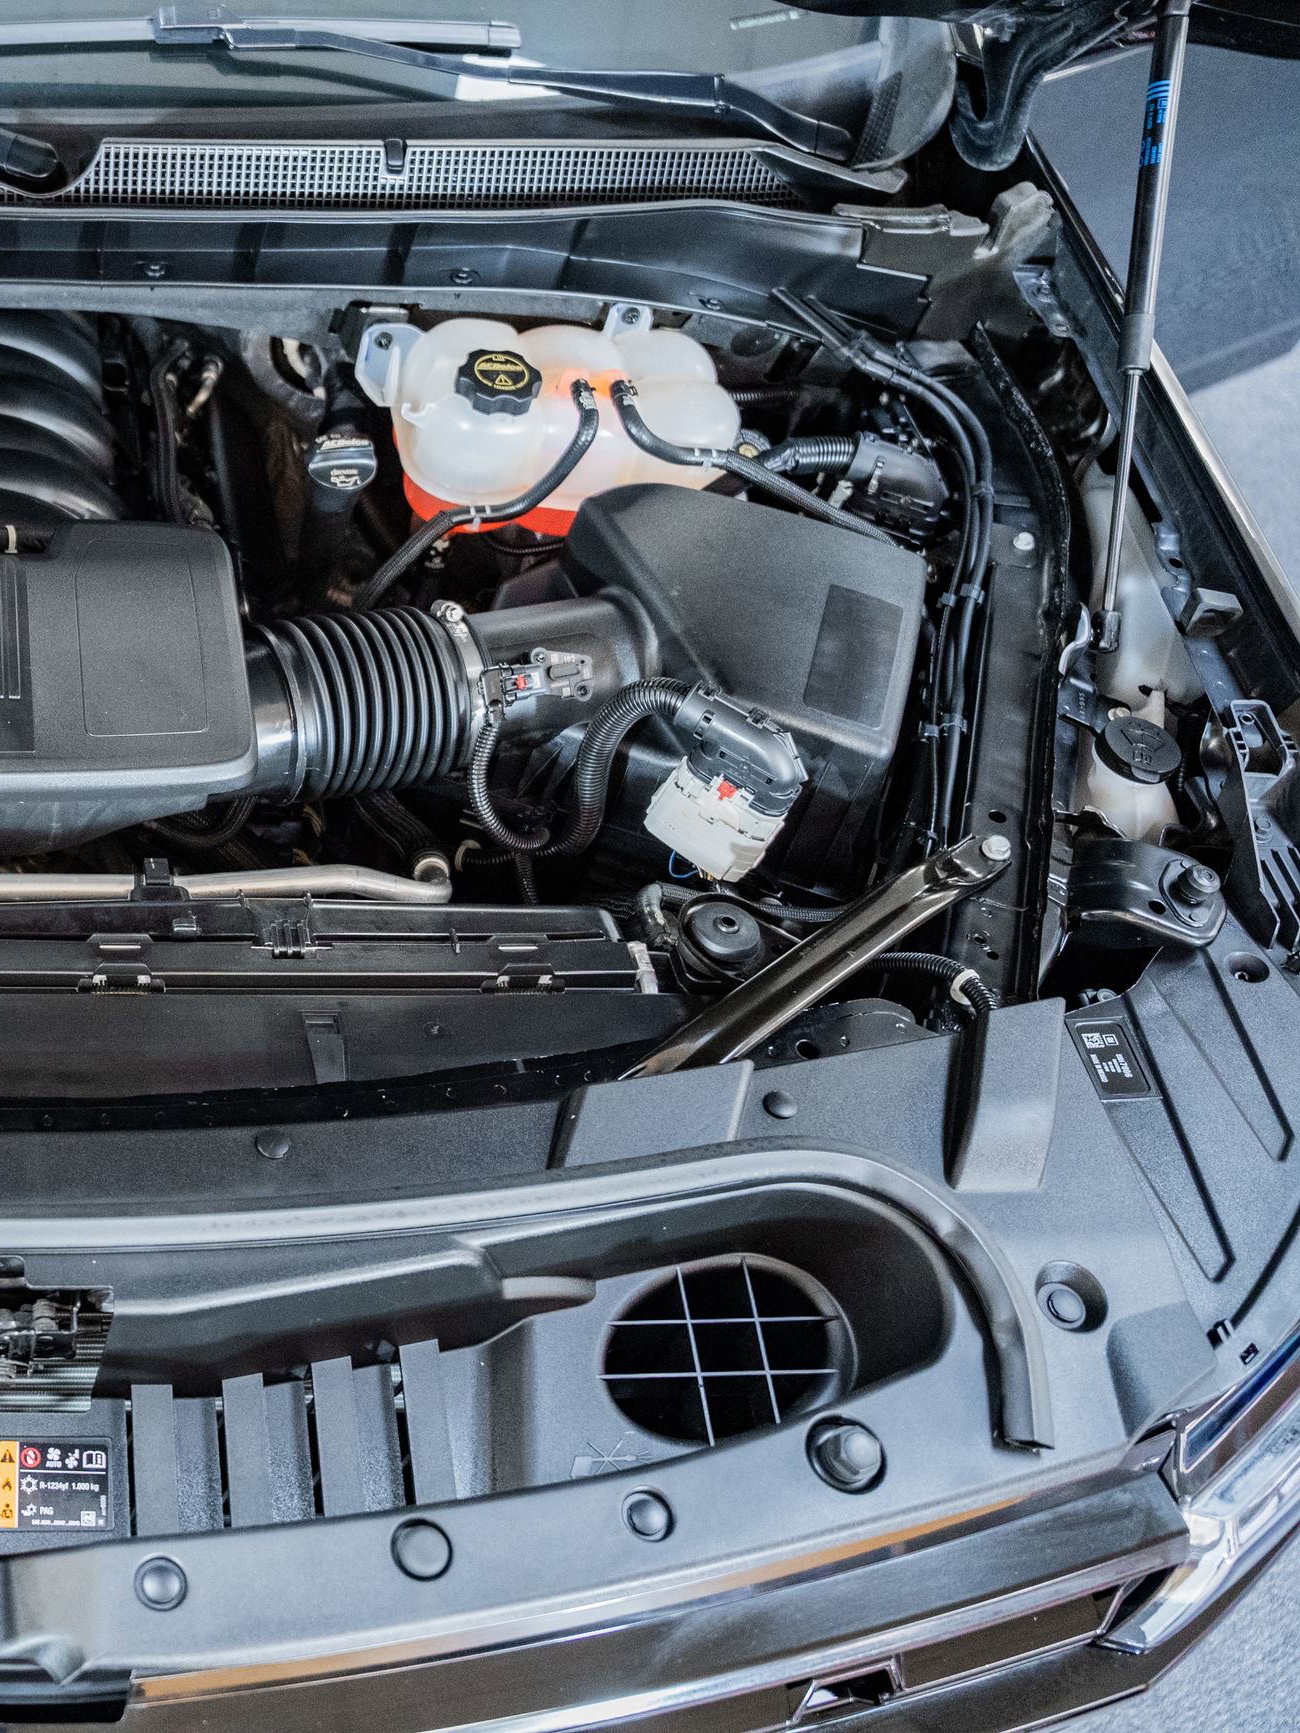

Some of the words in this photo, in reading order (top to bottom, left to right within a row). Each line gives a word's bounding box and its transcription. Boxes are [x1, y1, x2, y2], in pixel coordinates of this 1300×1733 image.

[39, 1481, 69, 1491] R-1234yf
[90, 1483, 99, 1492] kg
[39, 1506, 54, 1515] PAG
